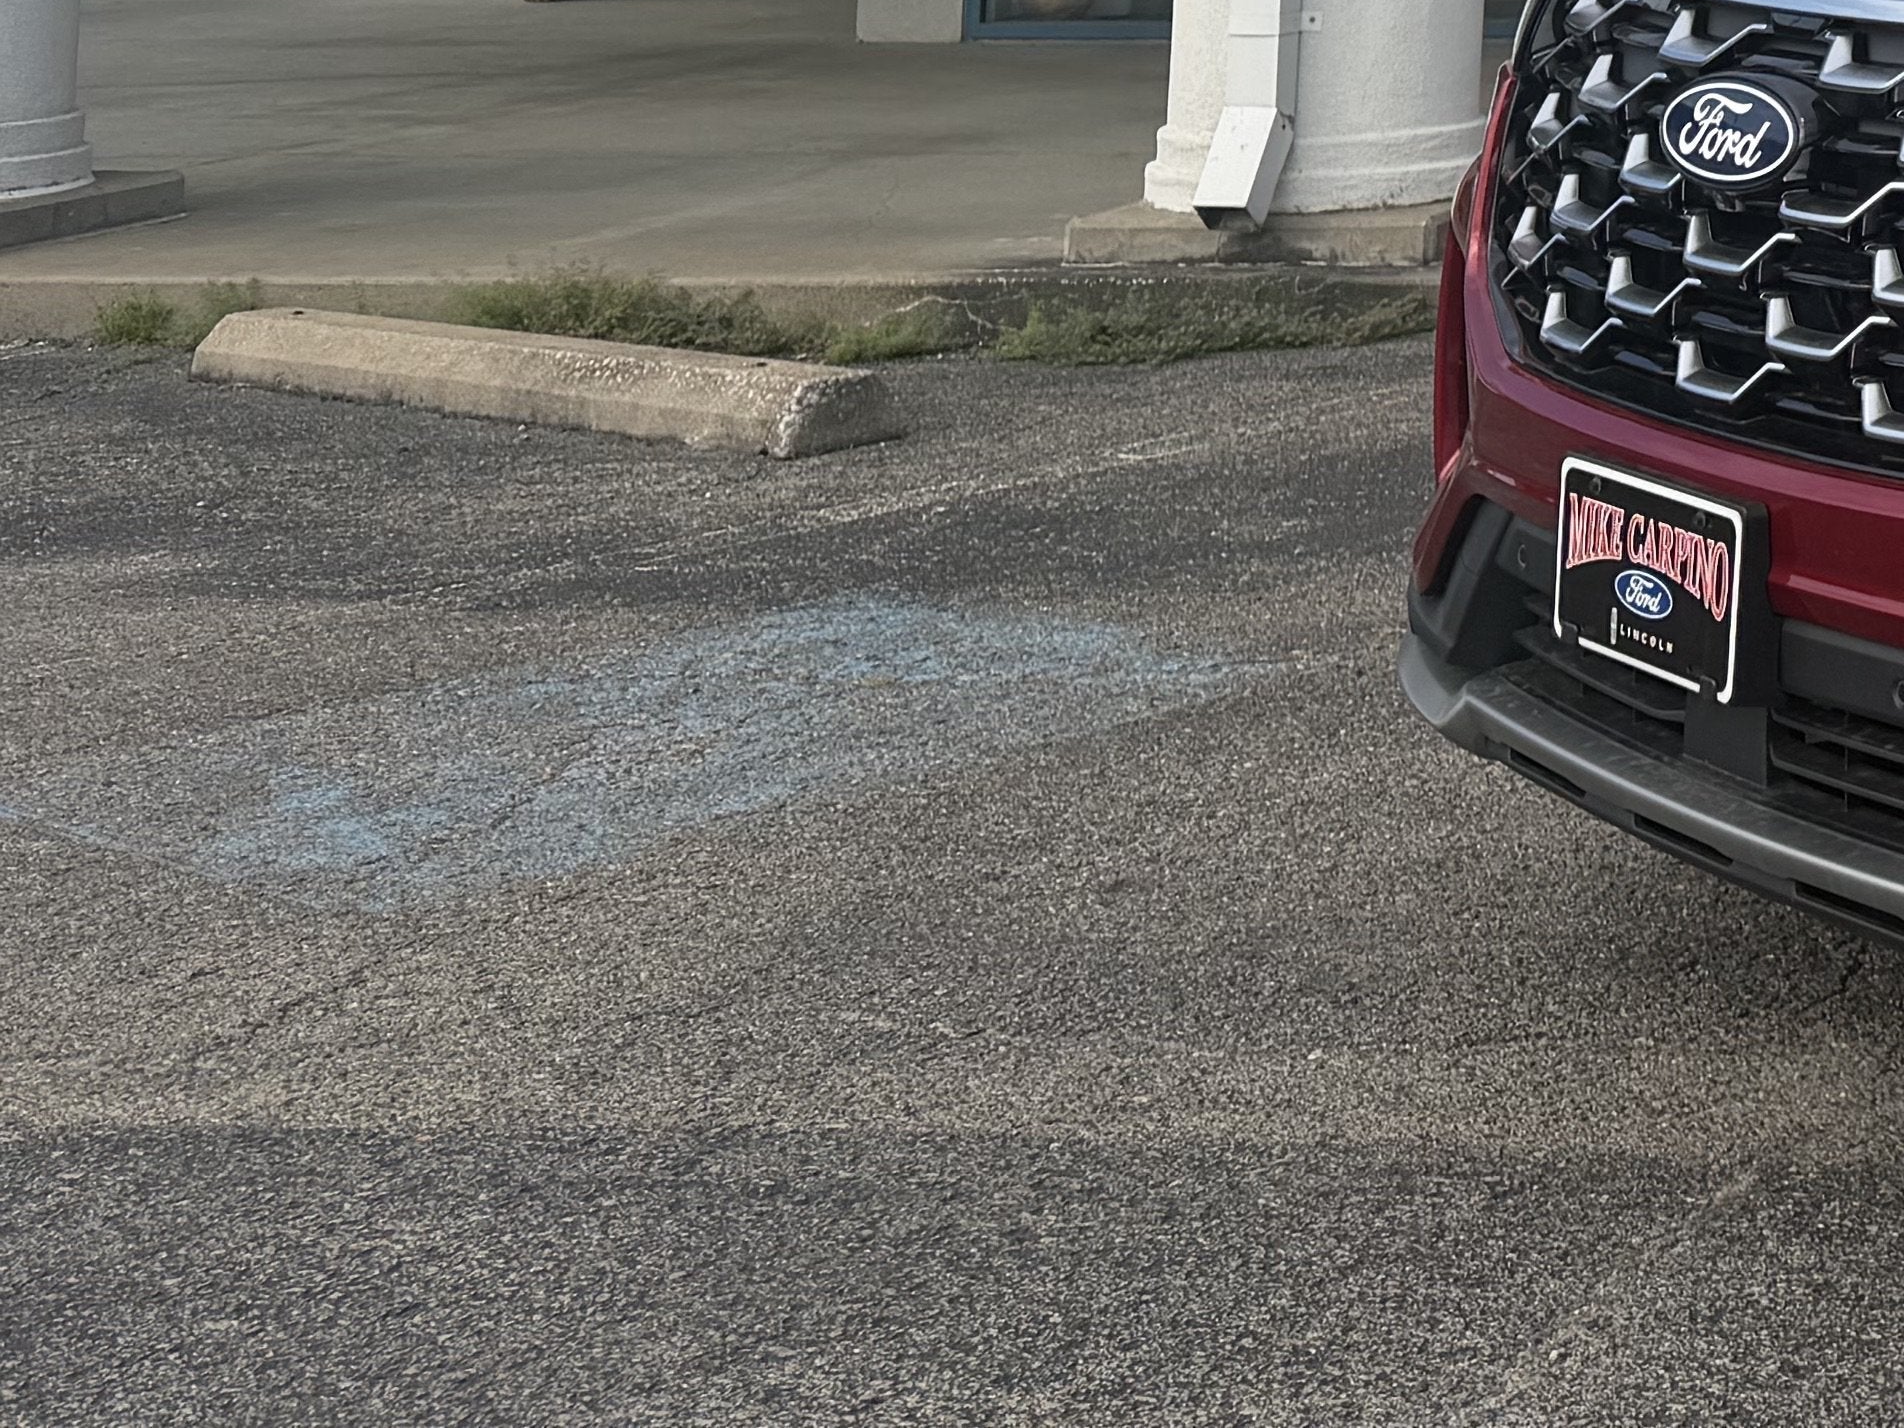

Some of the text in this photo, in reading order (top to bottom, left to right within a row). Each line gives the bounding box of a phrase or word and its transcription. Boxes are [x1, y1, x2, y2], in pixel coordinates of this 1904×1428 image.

[1678, 93, 1772, 169] Ford
[1565, 492, 1729, 622] MIKE CARPINO
[1625, 575, 1662, 613] Ford
[1620, 623, 1673, 654] LINCOLN
